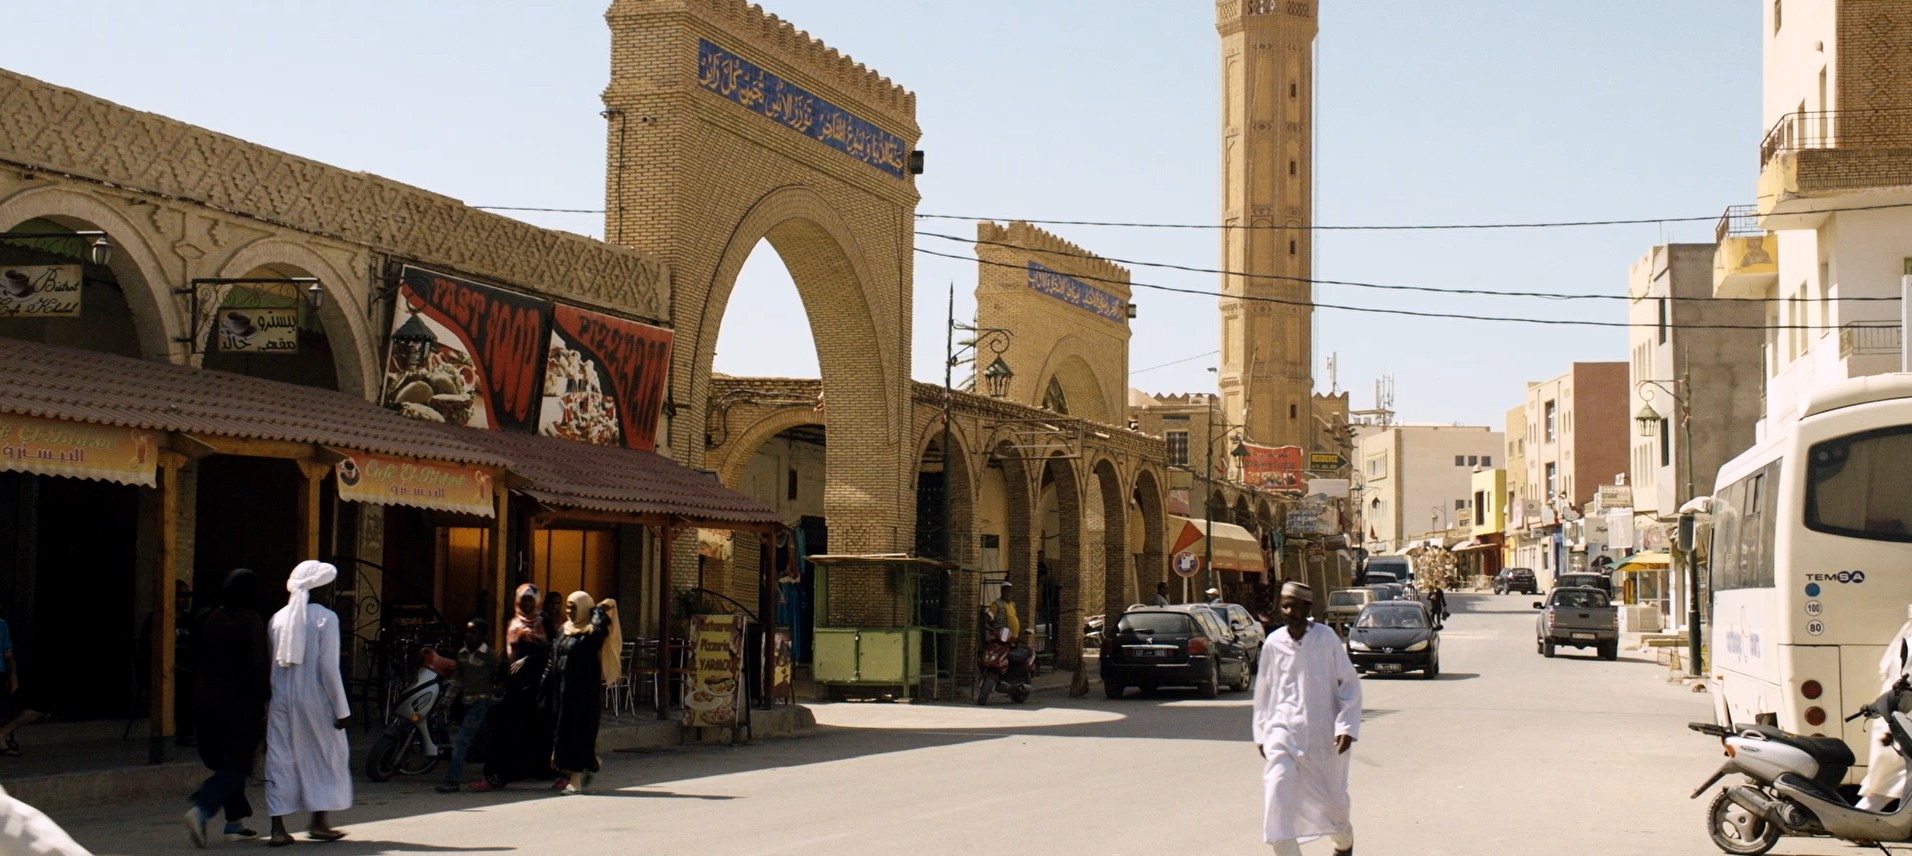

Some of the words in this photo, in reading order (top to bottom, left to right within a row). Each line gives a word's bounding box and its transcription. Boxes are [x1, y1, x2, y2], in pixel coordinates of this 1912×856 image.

[33, 267, 80, 293] Bistrot
[257, 311, 297, 334] بيسترو
[222, 336, 252, 351] خالد
[432, 277, 486, 339] FAST
[484, 299, 541, 423] FOOD
[1806, 570, 1865, 583] TEMSA
[1808, 603, 1820, 613] 100
[1810, 623, 1821, 632] 80
